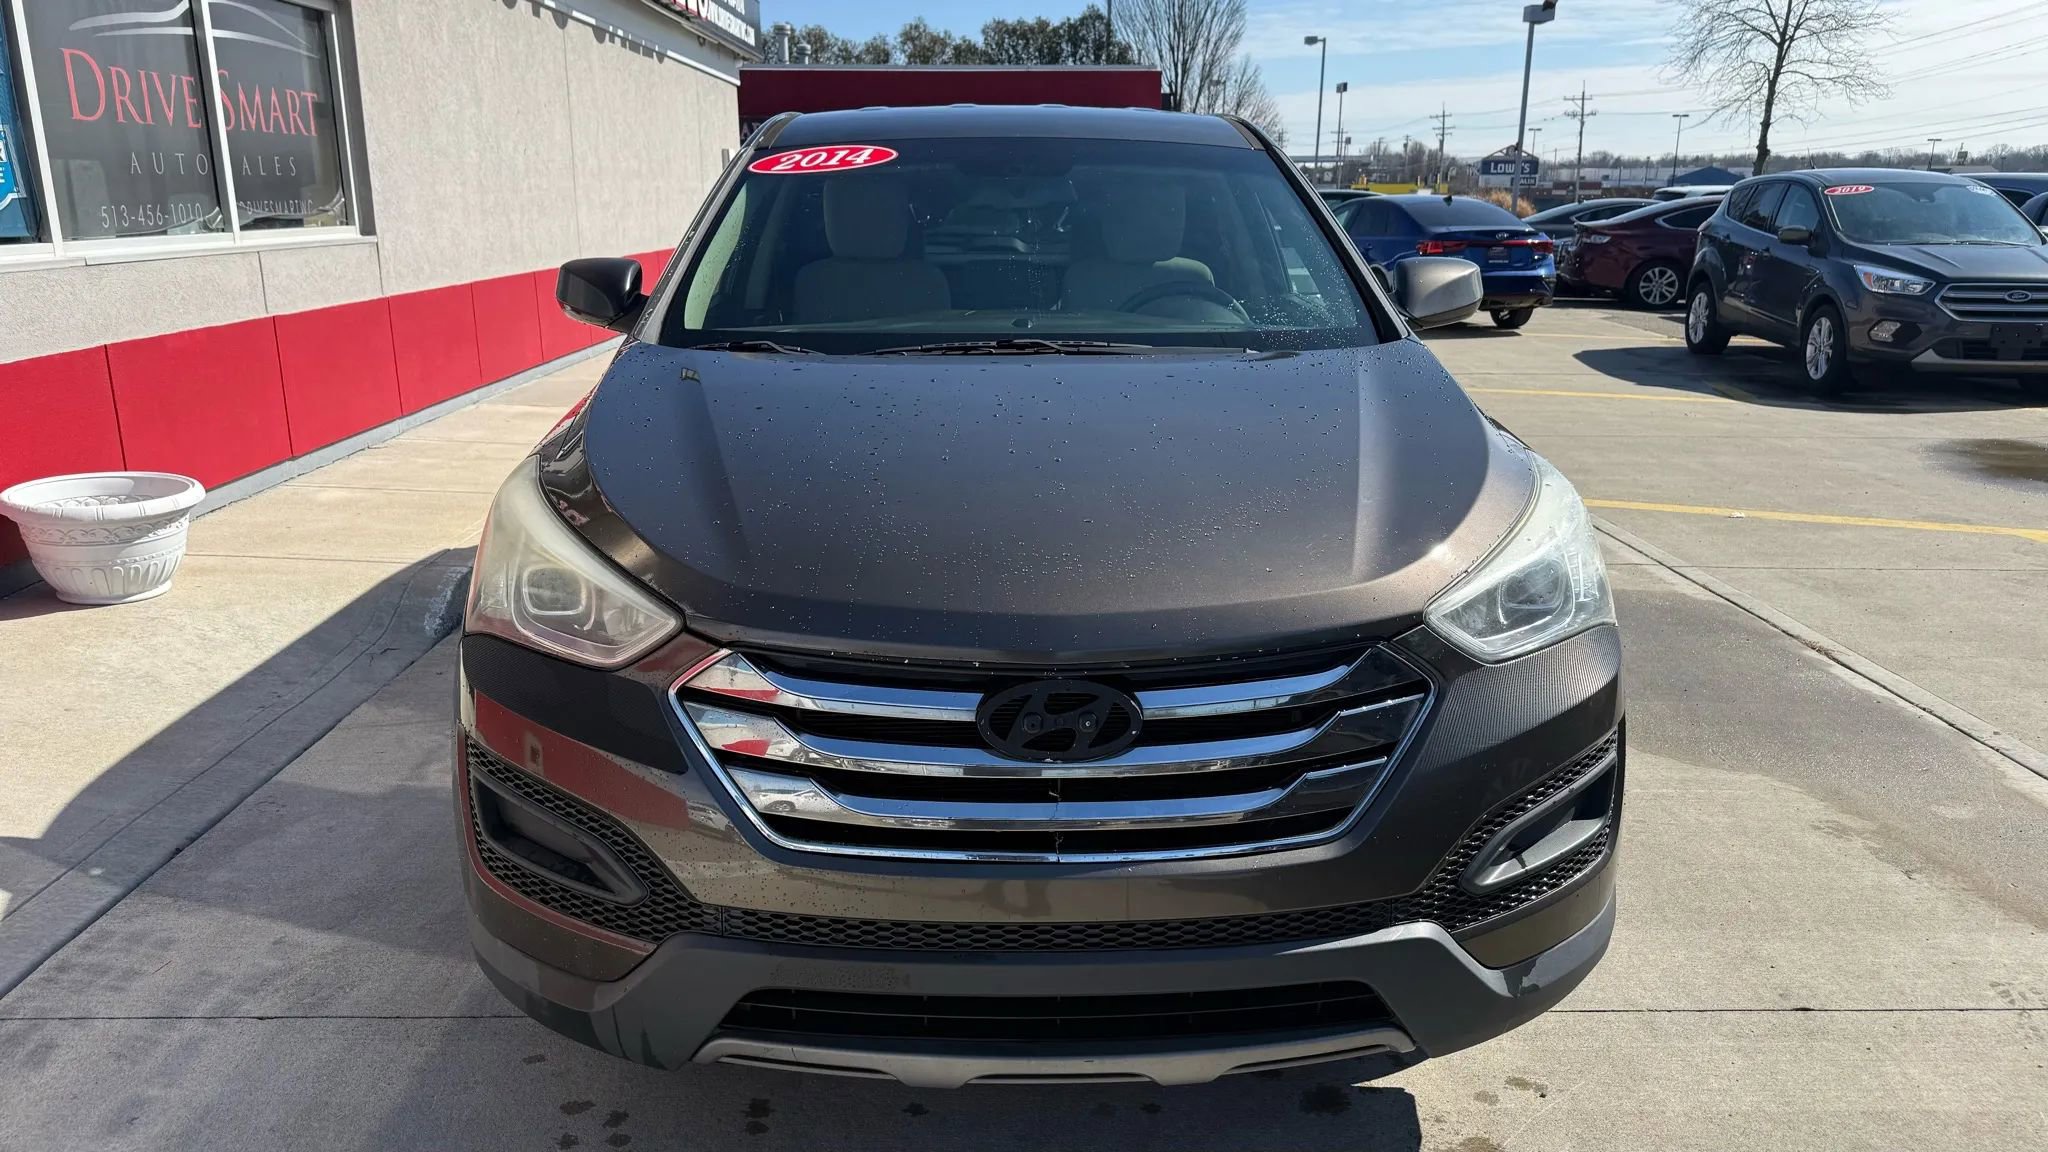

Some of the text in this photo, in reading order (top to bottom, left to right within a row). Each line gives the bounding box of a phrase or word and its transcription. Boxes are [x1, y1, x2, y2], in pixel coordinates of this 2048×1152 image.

[59, 47, 318, 137] DRIVE SMART
[130, 152, 297, 176] AUTO ALES
[770, 148, 874, 171] 2014
[1490, 162, 1530, 173] LOW'S
[101, 203, 203, 228] 513-456-1010
